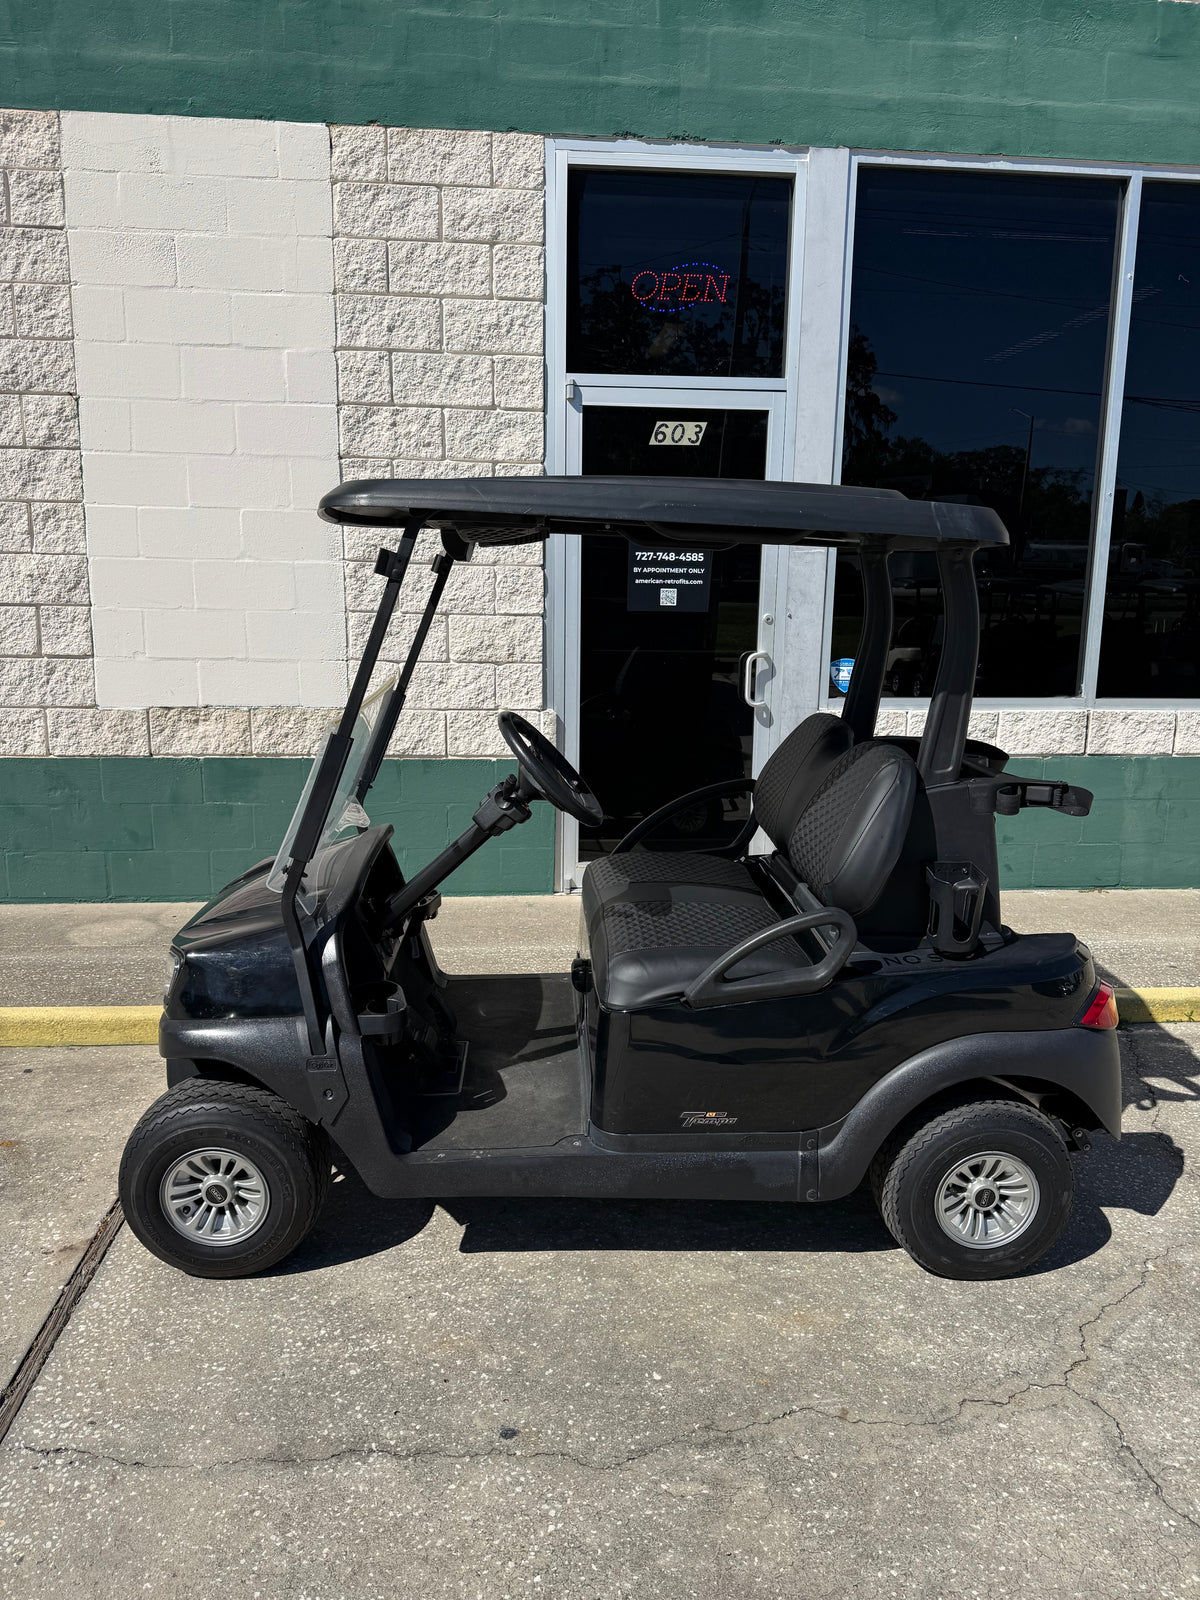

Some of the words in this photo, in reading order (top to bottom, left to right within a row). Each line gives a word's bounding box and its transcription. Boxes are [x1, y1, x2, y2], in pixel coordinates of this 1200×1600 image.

[631, 270, 731, 303] OPEN
[654, 423, 703, 444] 603
[635, 552, 704, 561] 727-748-4585
[882, 954, 921, 967] NO
